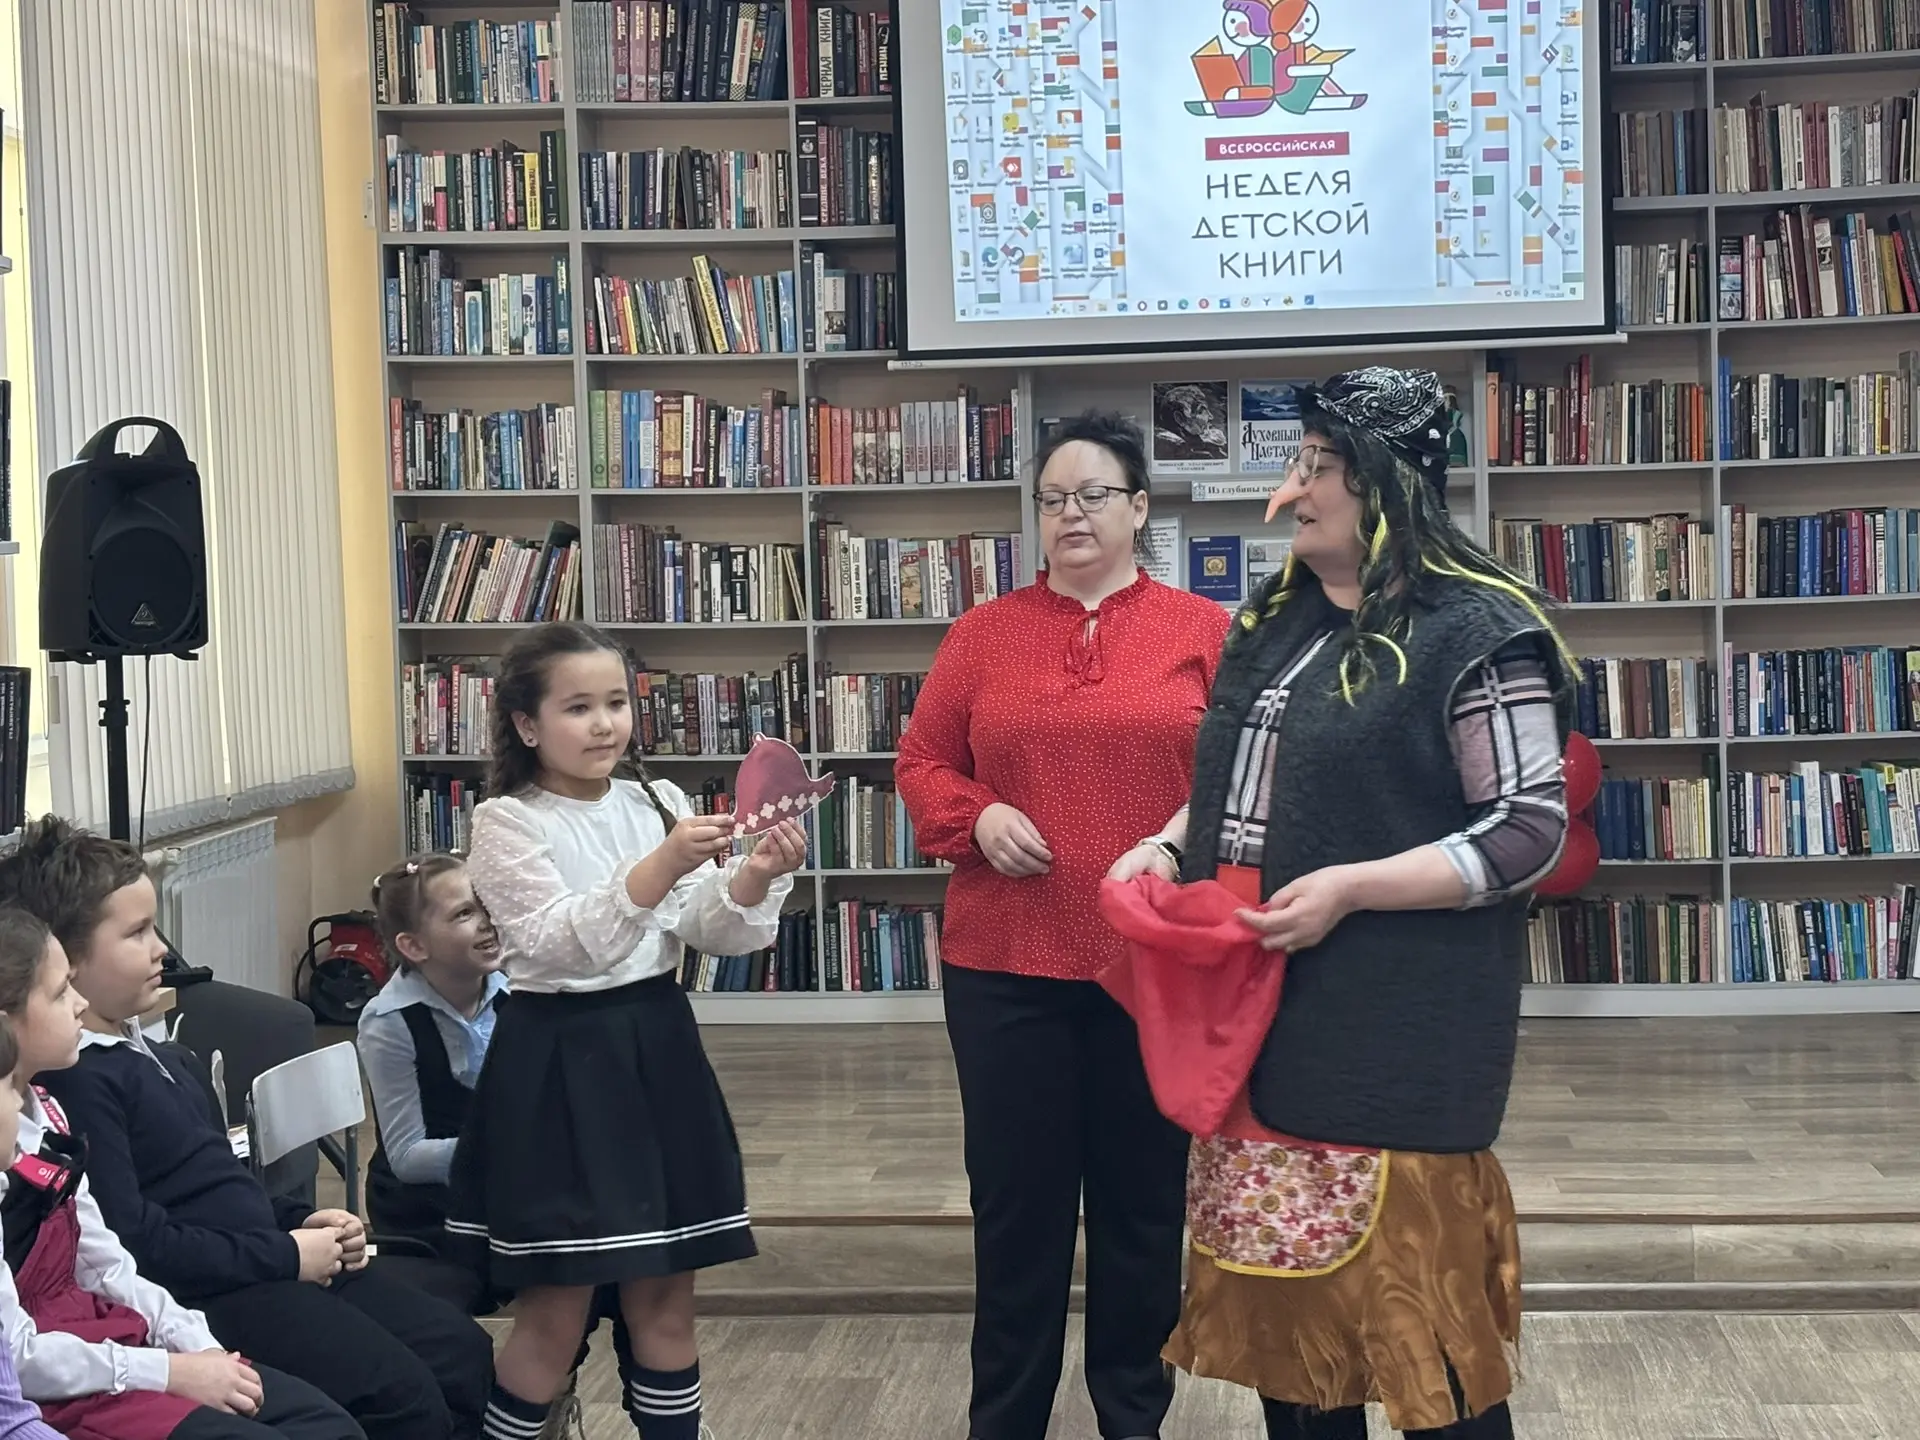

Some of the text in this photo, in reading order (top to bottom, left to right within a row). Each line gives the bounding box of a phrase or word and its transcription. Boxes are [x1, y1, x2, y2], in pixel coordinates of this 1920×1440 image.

[820, 9, 833, 95] ЧЕРНАЯ КНИГА
[1219, 139, 1336, 154] ВСЕРОССИЙСКАЯ
[819, 156, 828, 223] СРЕДНИЕ ВЕКА
[1207, 169, 1351, 199] НЕДЕЛЯ
[1191, 202, 1369, 239] ДЕТСКОЙ
[1219, 249, 1342, 279] КНИГИ
[1208, 485, 1220, 494] Из
[1221, 484, 1260, 496] глубины
[973, 565, 985, 594] ПАМЯТЬ
